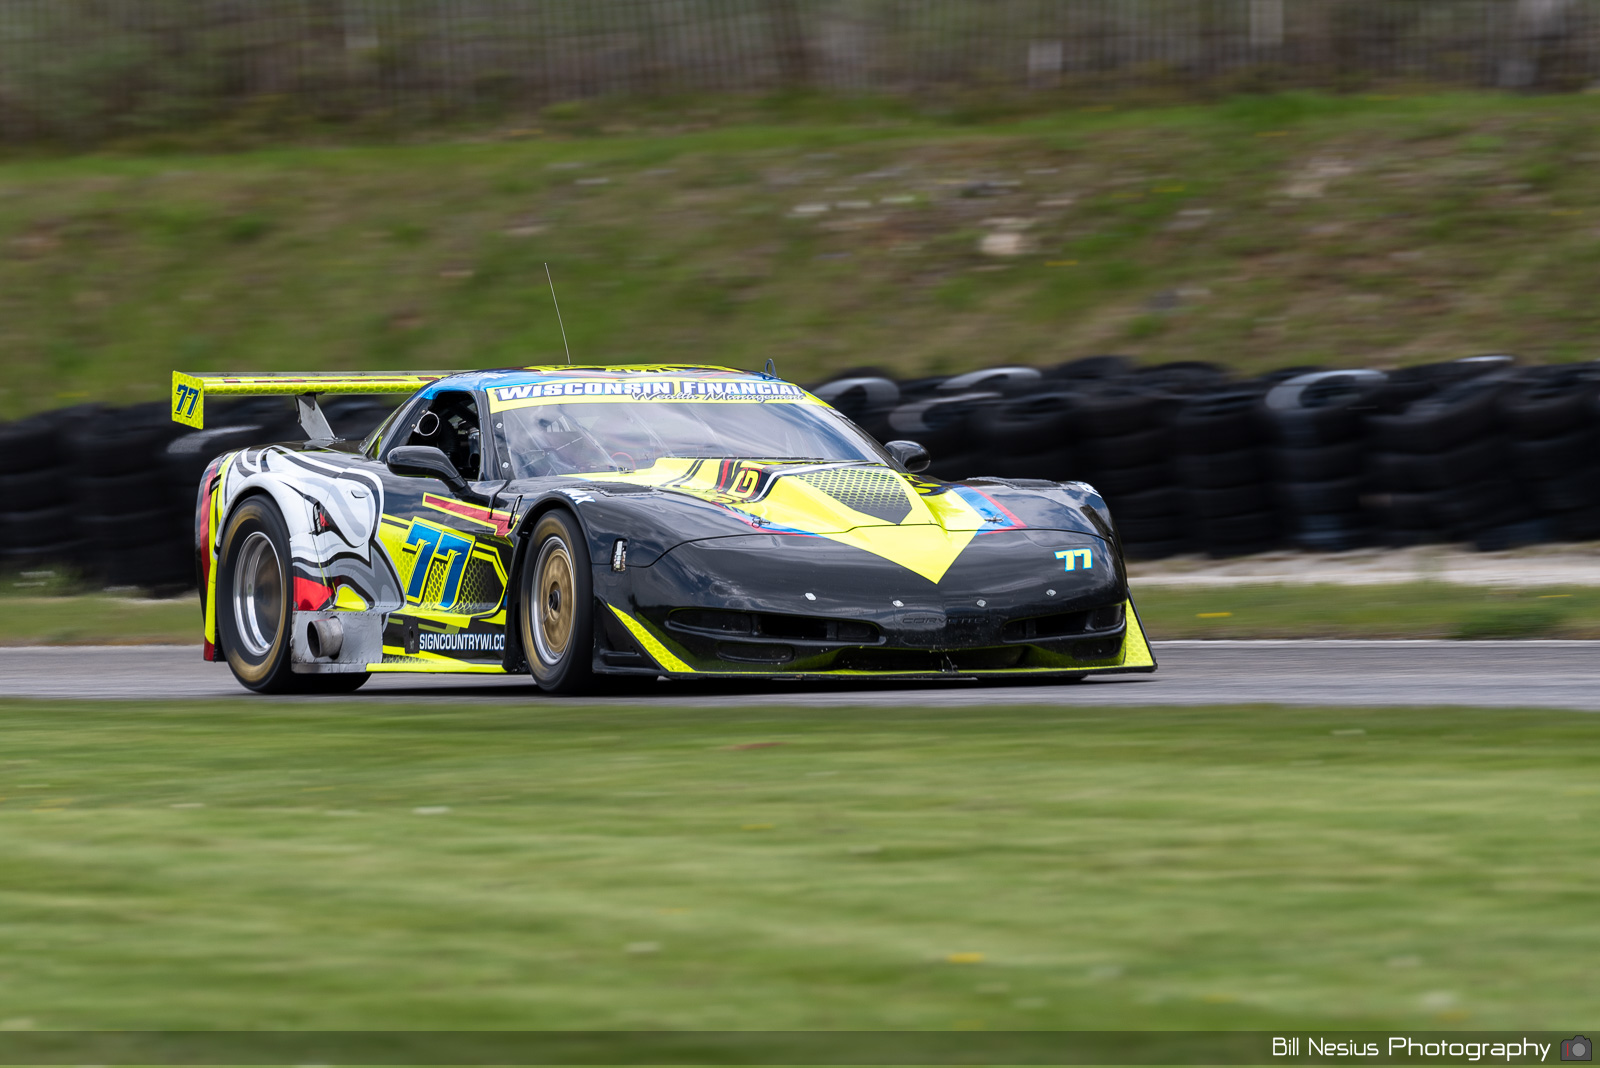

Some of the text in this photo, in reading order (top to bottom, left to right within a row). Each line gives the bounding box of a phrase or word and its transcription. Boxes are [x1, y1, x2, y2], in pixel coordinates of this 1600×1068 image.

[175, 383, 201, 419] 77
[497, 381, 806, 401] WISCONSIN FINANCIAL
[631, 390, 804, 402] Wealth Management
[403, 520, 474, 610] 77
[1054, 548, 1093, 572] 77
[902, 616, 986, 625] CORVTTE
[419, 633, 505, 650] SIGNCOUNTRYWI.CO
